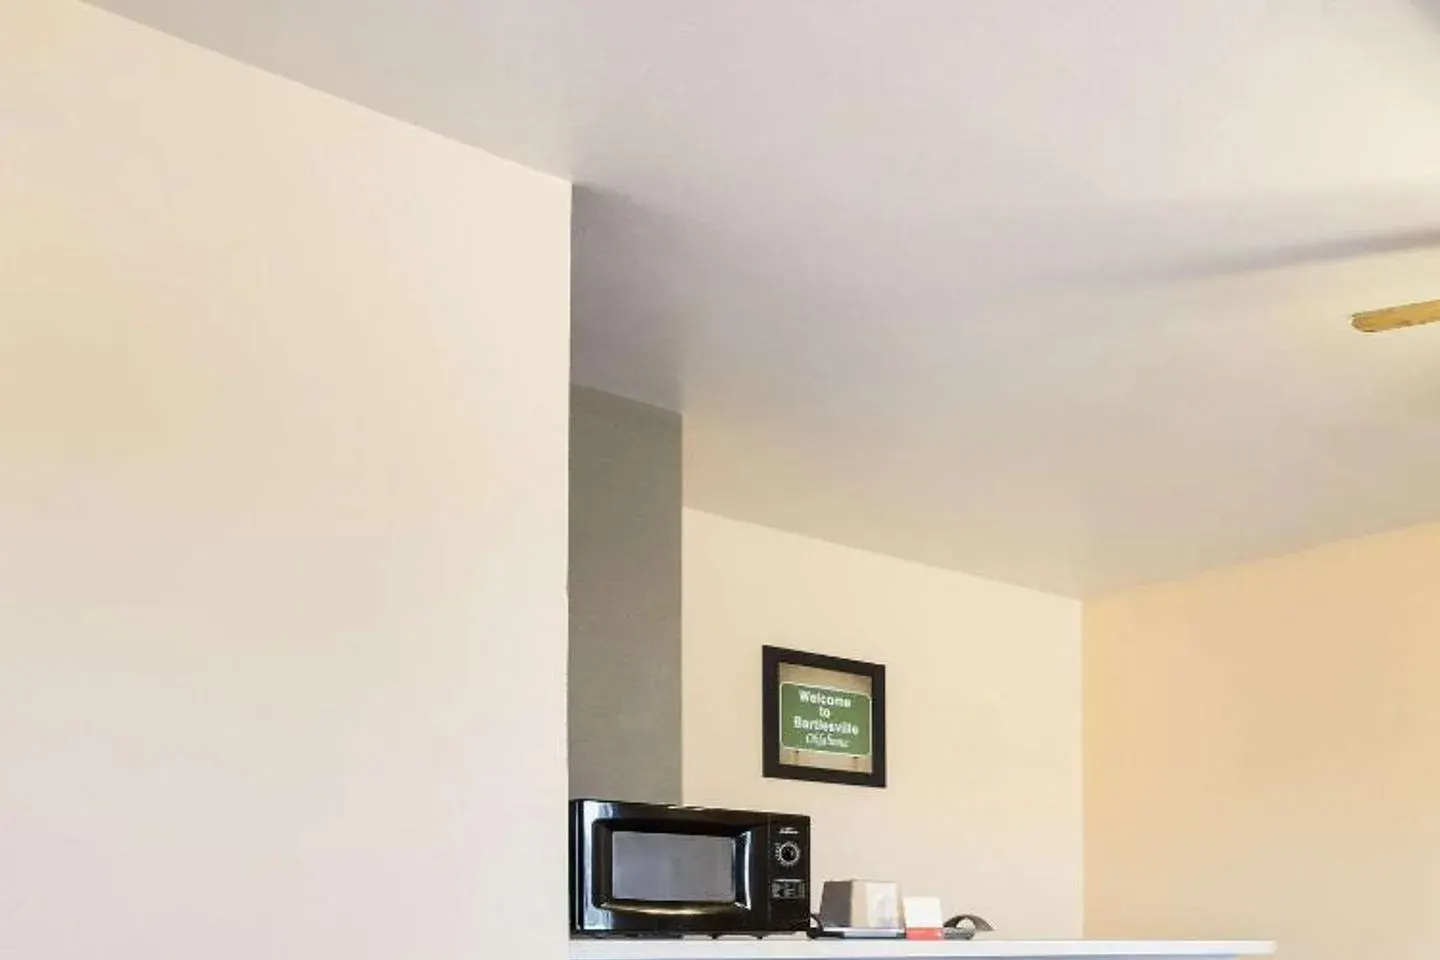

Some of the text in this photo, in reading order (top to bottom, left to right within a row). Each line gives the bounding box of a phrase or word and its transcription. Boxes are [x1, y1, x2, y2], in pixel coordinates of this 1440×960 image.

[798, 689, 851, 708] Welcome
[818, 705, 831, 719] to
[793, 715, 860, 736] Bartlesville
